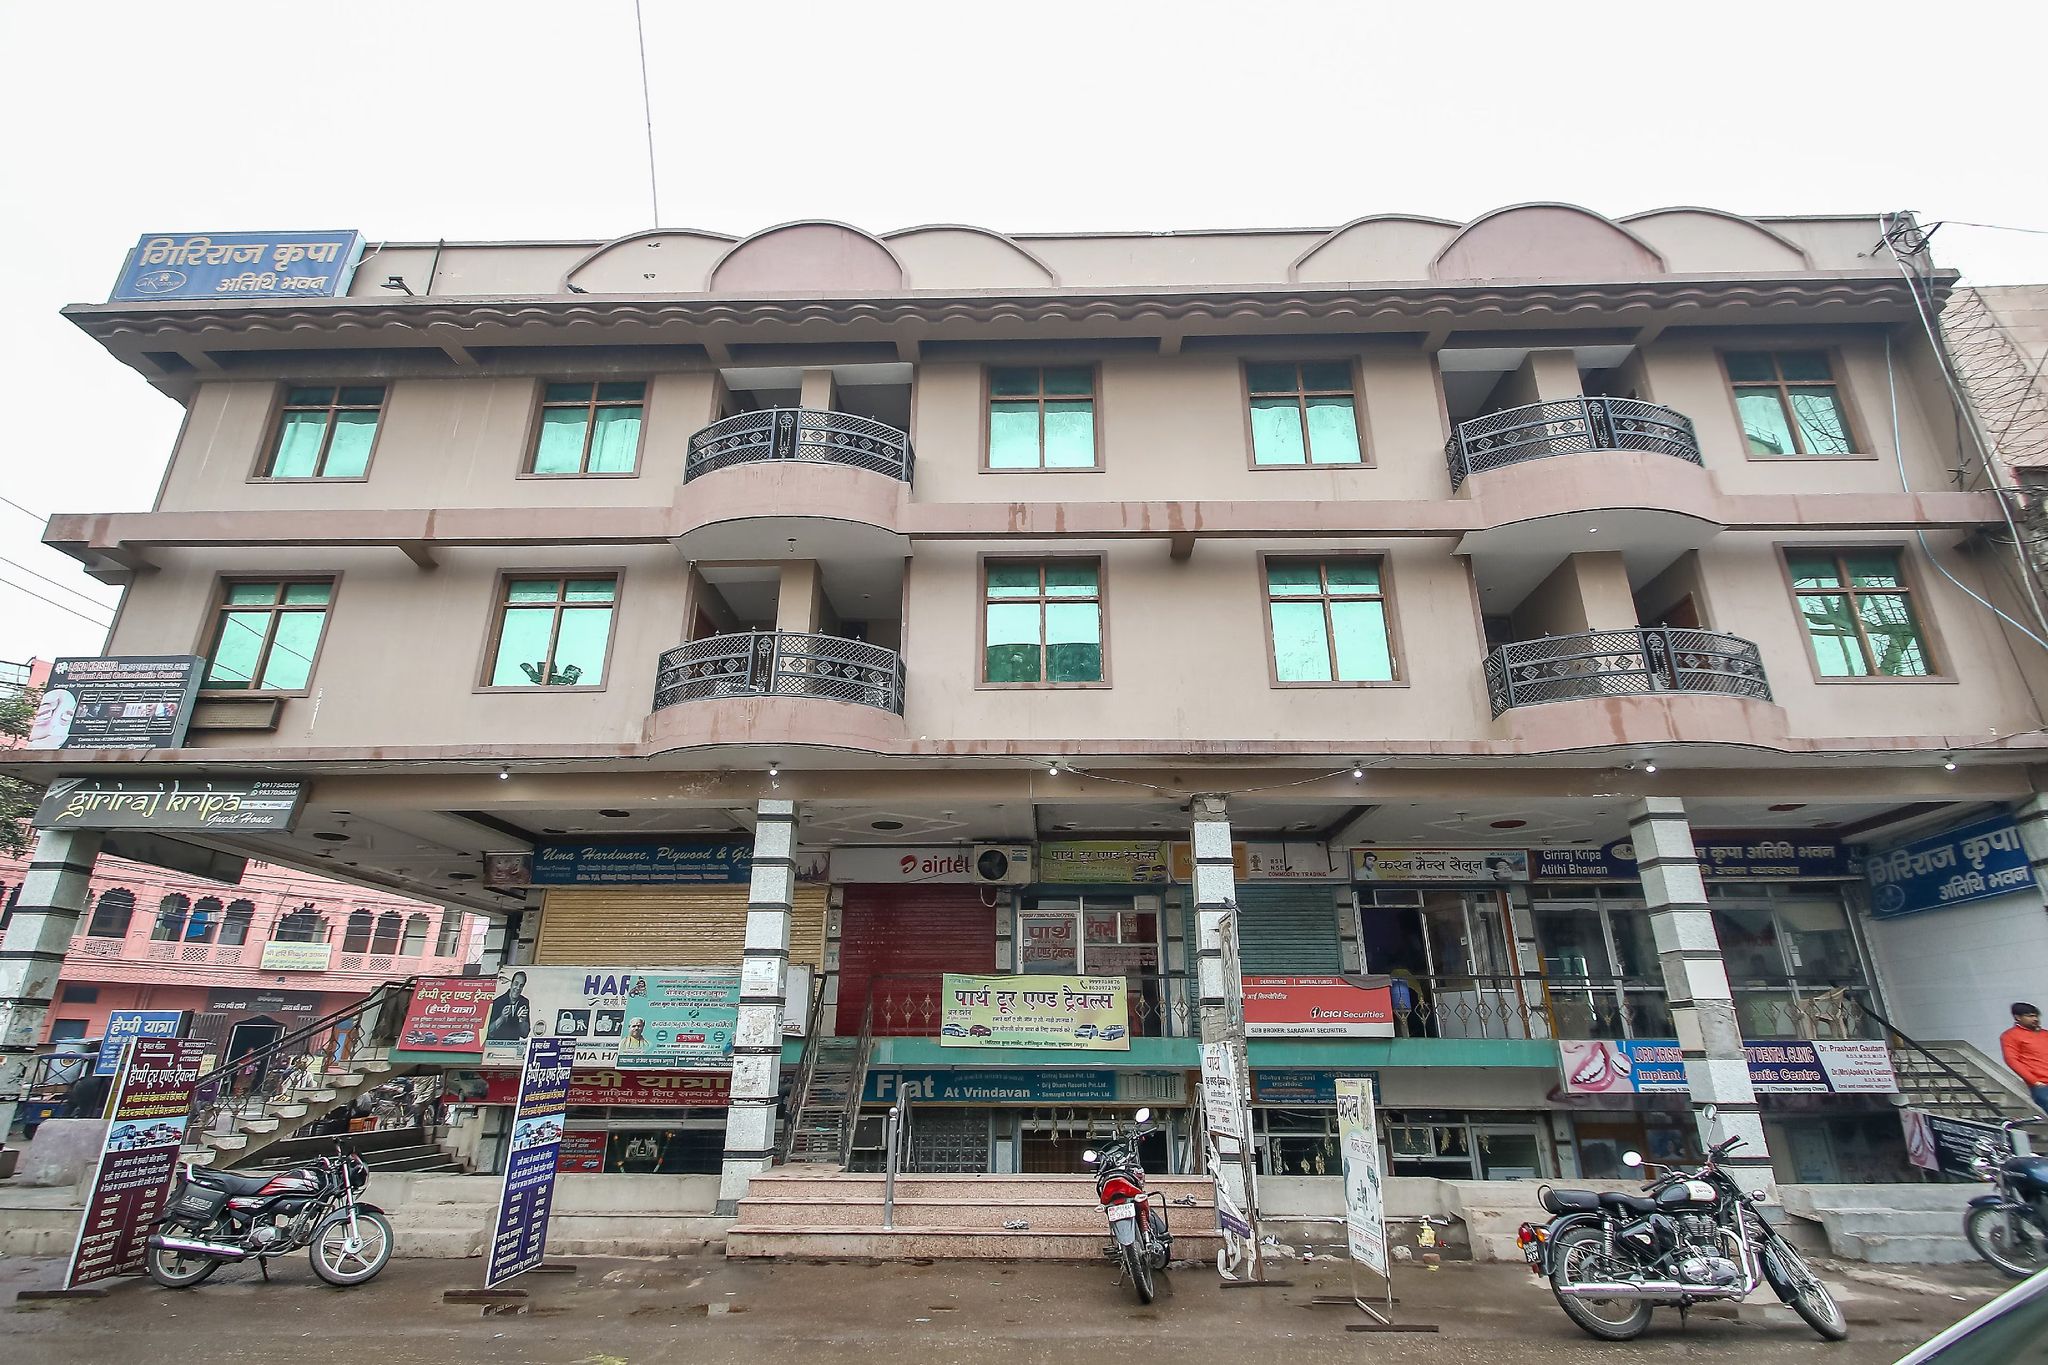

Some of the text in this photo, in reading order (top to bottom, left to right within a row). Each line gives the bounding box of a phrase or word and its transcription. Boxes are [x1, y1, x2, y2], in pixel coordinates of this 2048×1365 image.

[139, 237, 342, 271] गिरिराज कृपा
[216, 272, 328, 293] अतिथि भवन
[55, 780, 246, 822] giriraj kripa
[206, 812, 274, 827] Guest House
[542, 846, 727, 862] Uma Hardware, Plywood &
[1050, 847, 1121, 864] पार्थ टूर एण्ड
[1543, 850, 1601, 863] Giriraj Kripa
[1709, 841, 1835, 864] कृपा अतिथि भवन
[1866, 825, 2020, 886] गिरिराज कृपा
[921, 855, 970, 873] airtel
[1378, 856, 1484, 875] करन मैन्स सैलून
[1540, 864, 1608, 875] Atithi Bhawan
[1938, 866, 2030, 901] अतिथि भवन
[1028, 920, 1073, 940] पार्थ
[417, 988, 473, 1003] हैप्पी टूर एण्ड
[954, 985, 1114, 1014] पार्थ टूर एण्ड ट्रैवल्स
[425, 1003, 477, 1015] (हैप्पी यात्रा)
[1320, 1009, 1385, 1019] ICICI Securities
[110, 1015, 176, 1035] हैप्पी यात्रा
[1632, 1047, 1655, 1063] LORD
[1757, 1046, 1789, 1063] DENTAL
[1789, 1046, 1815, 1063] CLINIC
[128, 1062, 150, 1086] हैप्पी
[146, 1069, 160, 1089] टूर
[637, 1076, 729, 1089] यात्रा
[1637, 1068, 1682, 1083] Implant
[1780, 1068, 1821, 1081] Centre
[944, 1086, 1031, 1098] At Vrindavan
